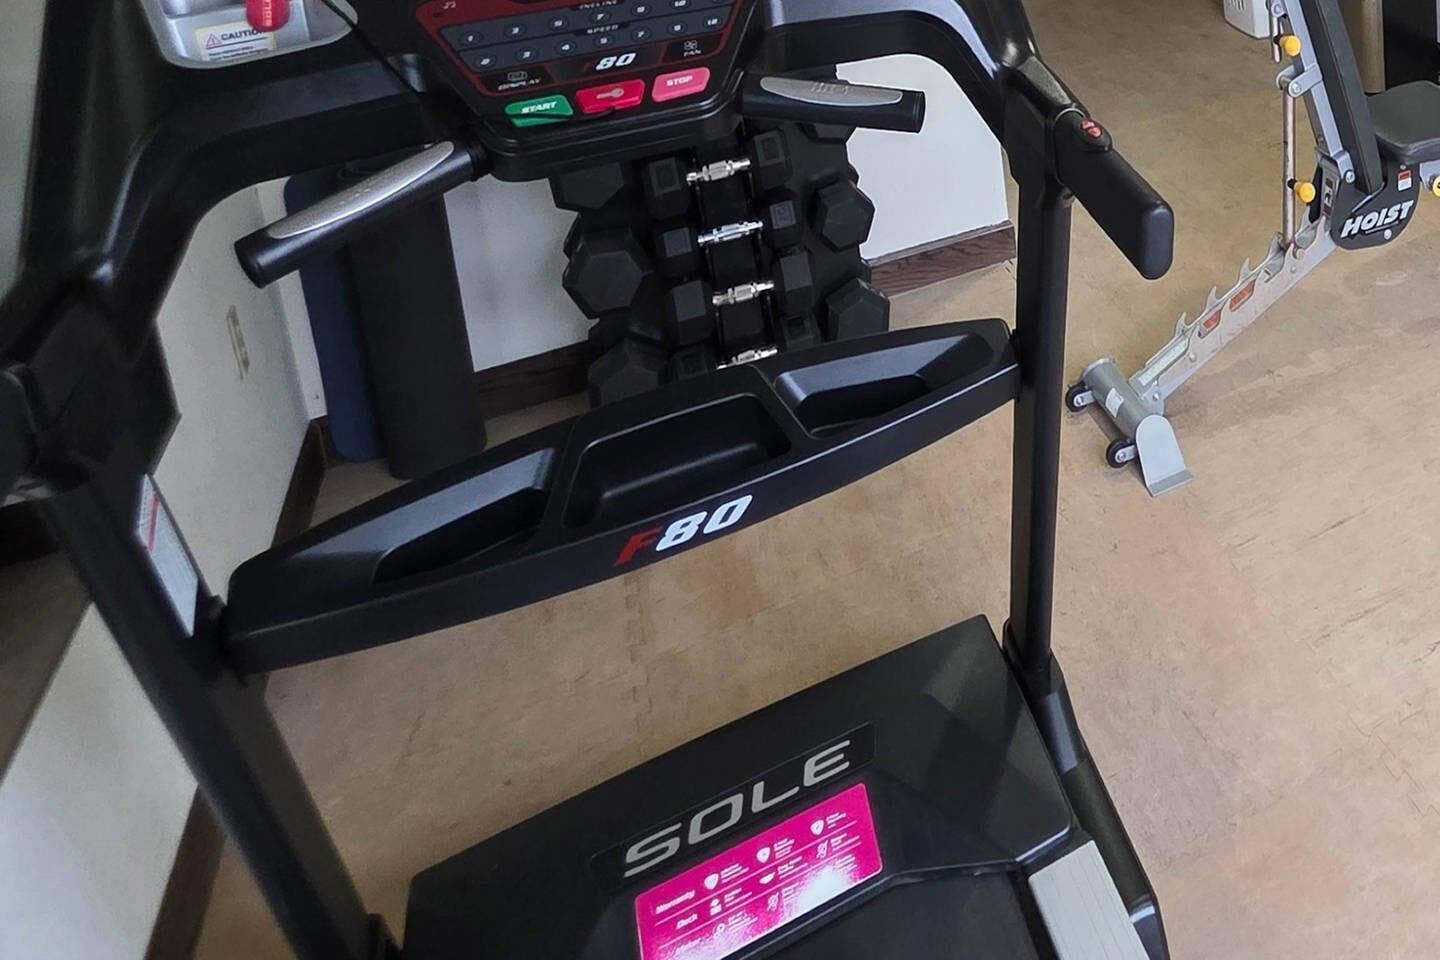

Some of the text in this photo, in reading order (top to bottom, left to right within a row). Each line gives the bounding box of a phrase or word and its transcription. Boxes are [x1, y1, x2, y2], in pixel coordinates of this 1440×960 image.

[221, 26, 263, 41] CAUTIO
[596, 52, 637, 71] 80
[666, 74, 694, 87] STOP
[521, 100, 558, 114] START
[1340, 200, 1414, 238] HOIST
[613, 494, 753, 567] F80
[624, 740, 850, 878] SOLE
